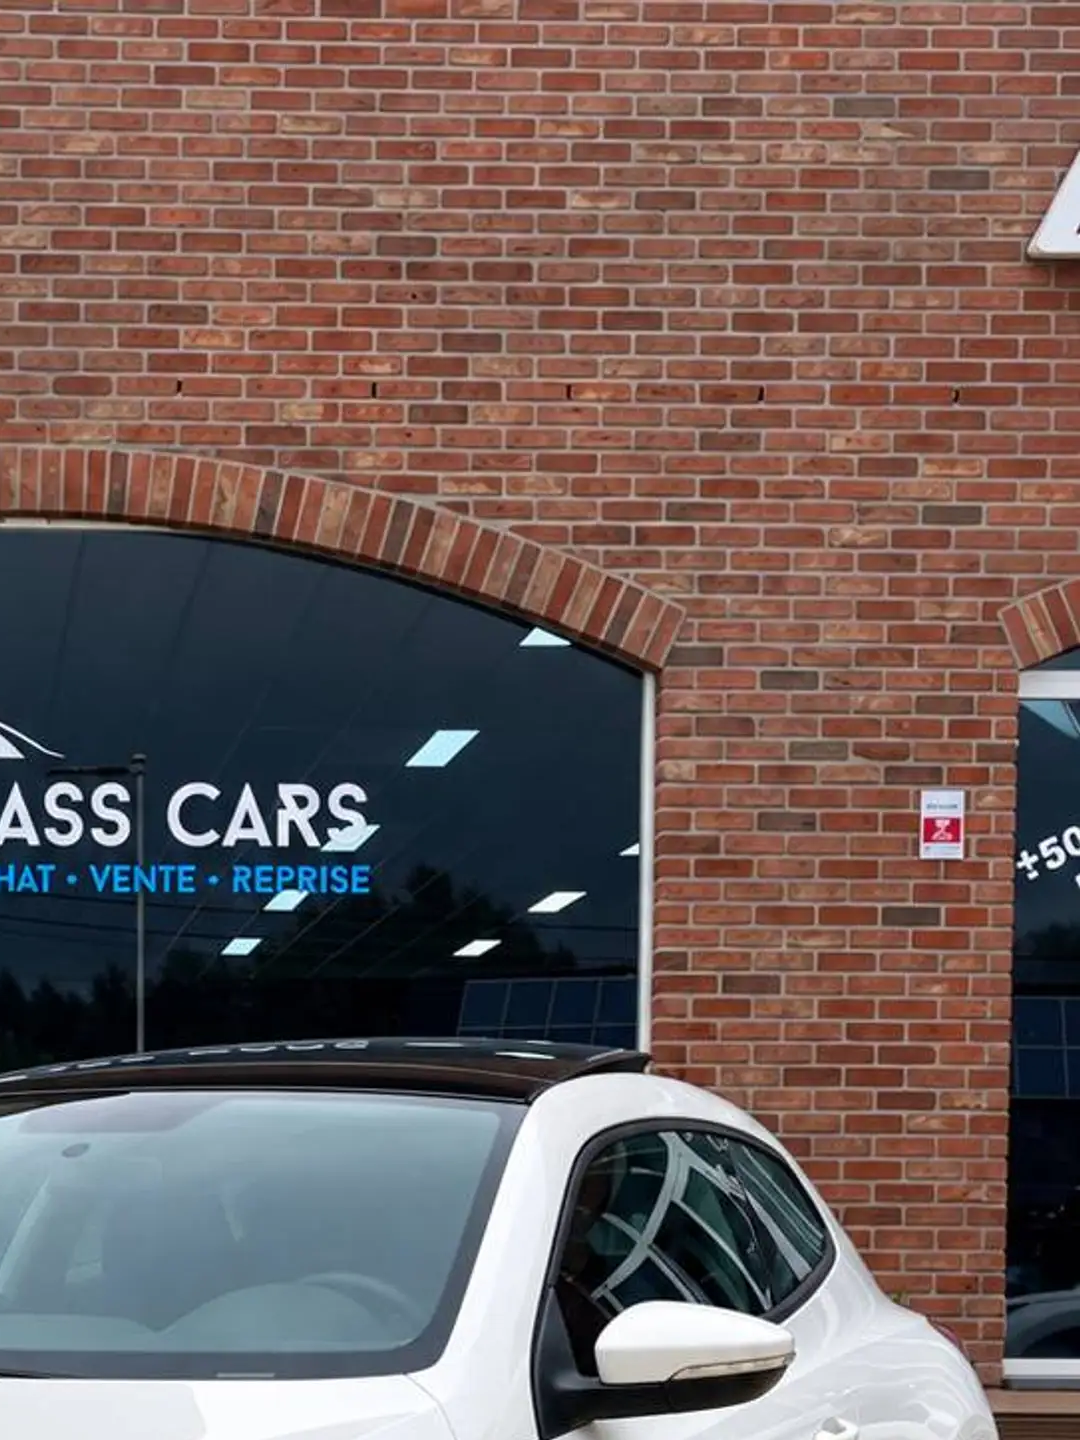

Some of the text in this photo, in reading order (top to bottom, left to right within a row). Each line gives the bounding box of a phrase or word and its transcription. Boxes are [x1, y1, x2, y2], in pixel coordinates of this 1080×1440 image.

[166, 782, 370, 848] CARS
[89, 865, 196, 893] VENTE
[232, 865, 371, 893] REPRISE
